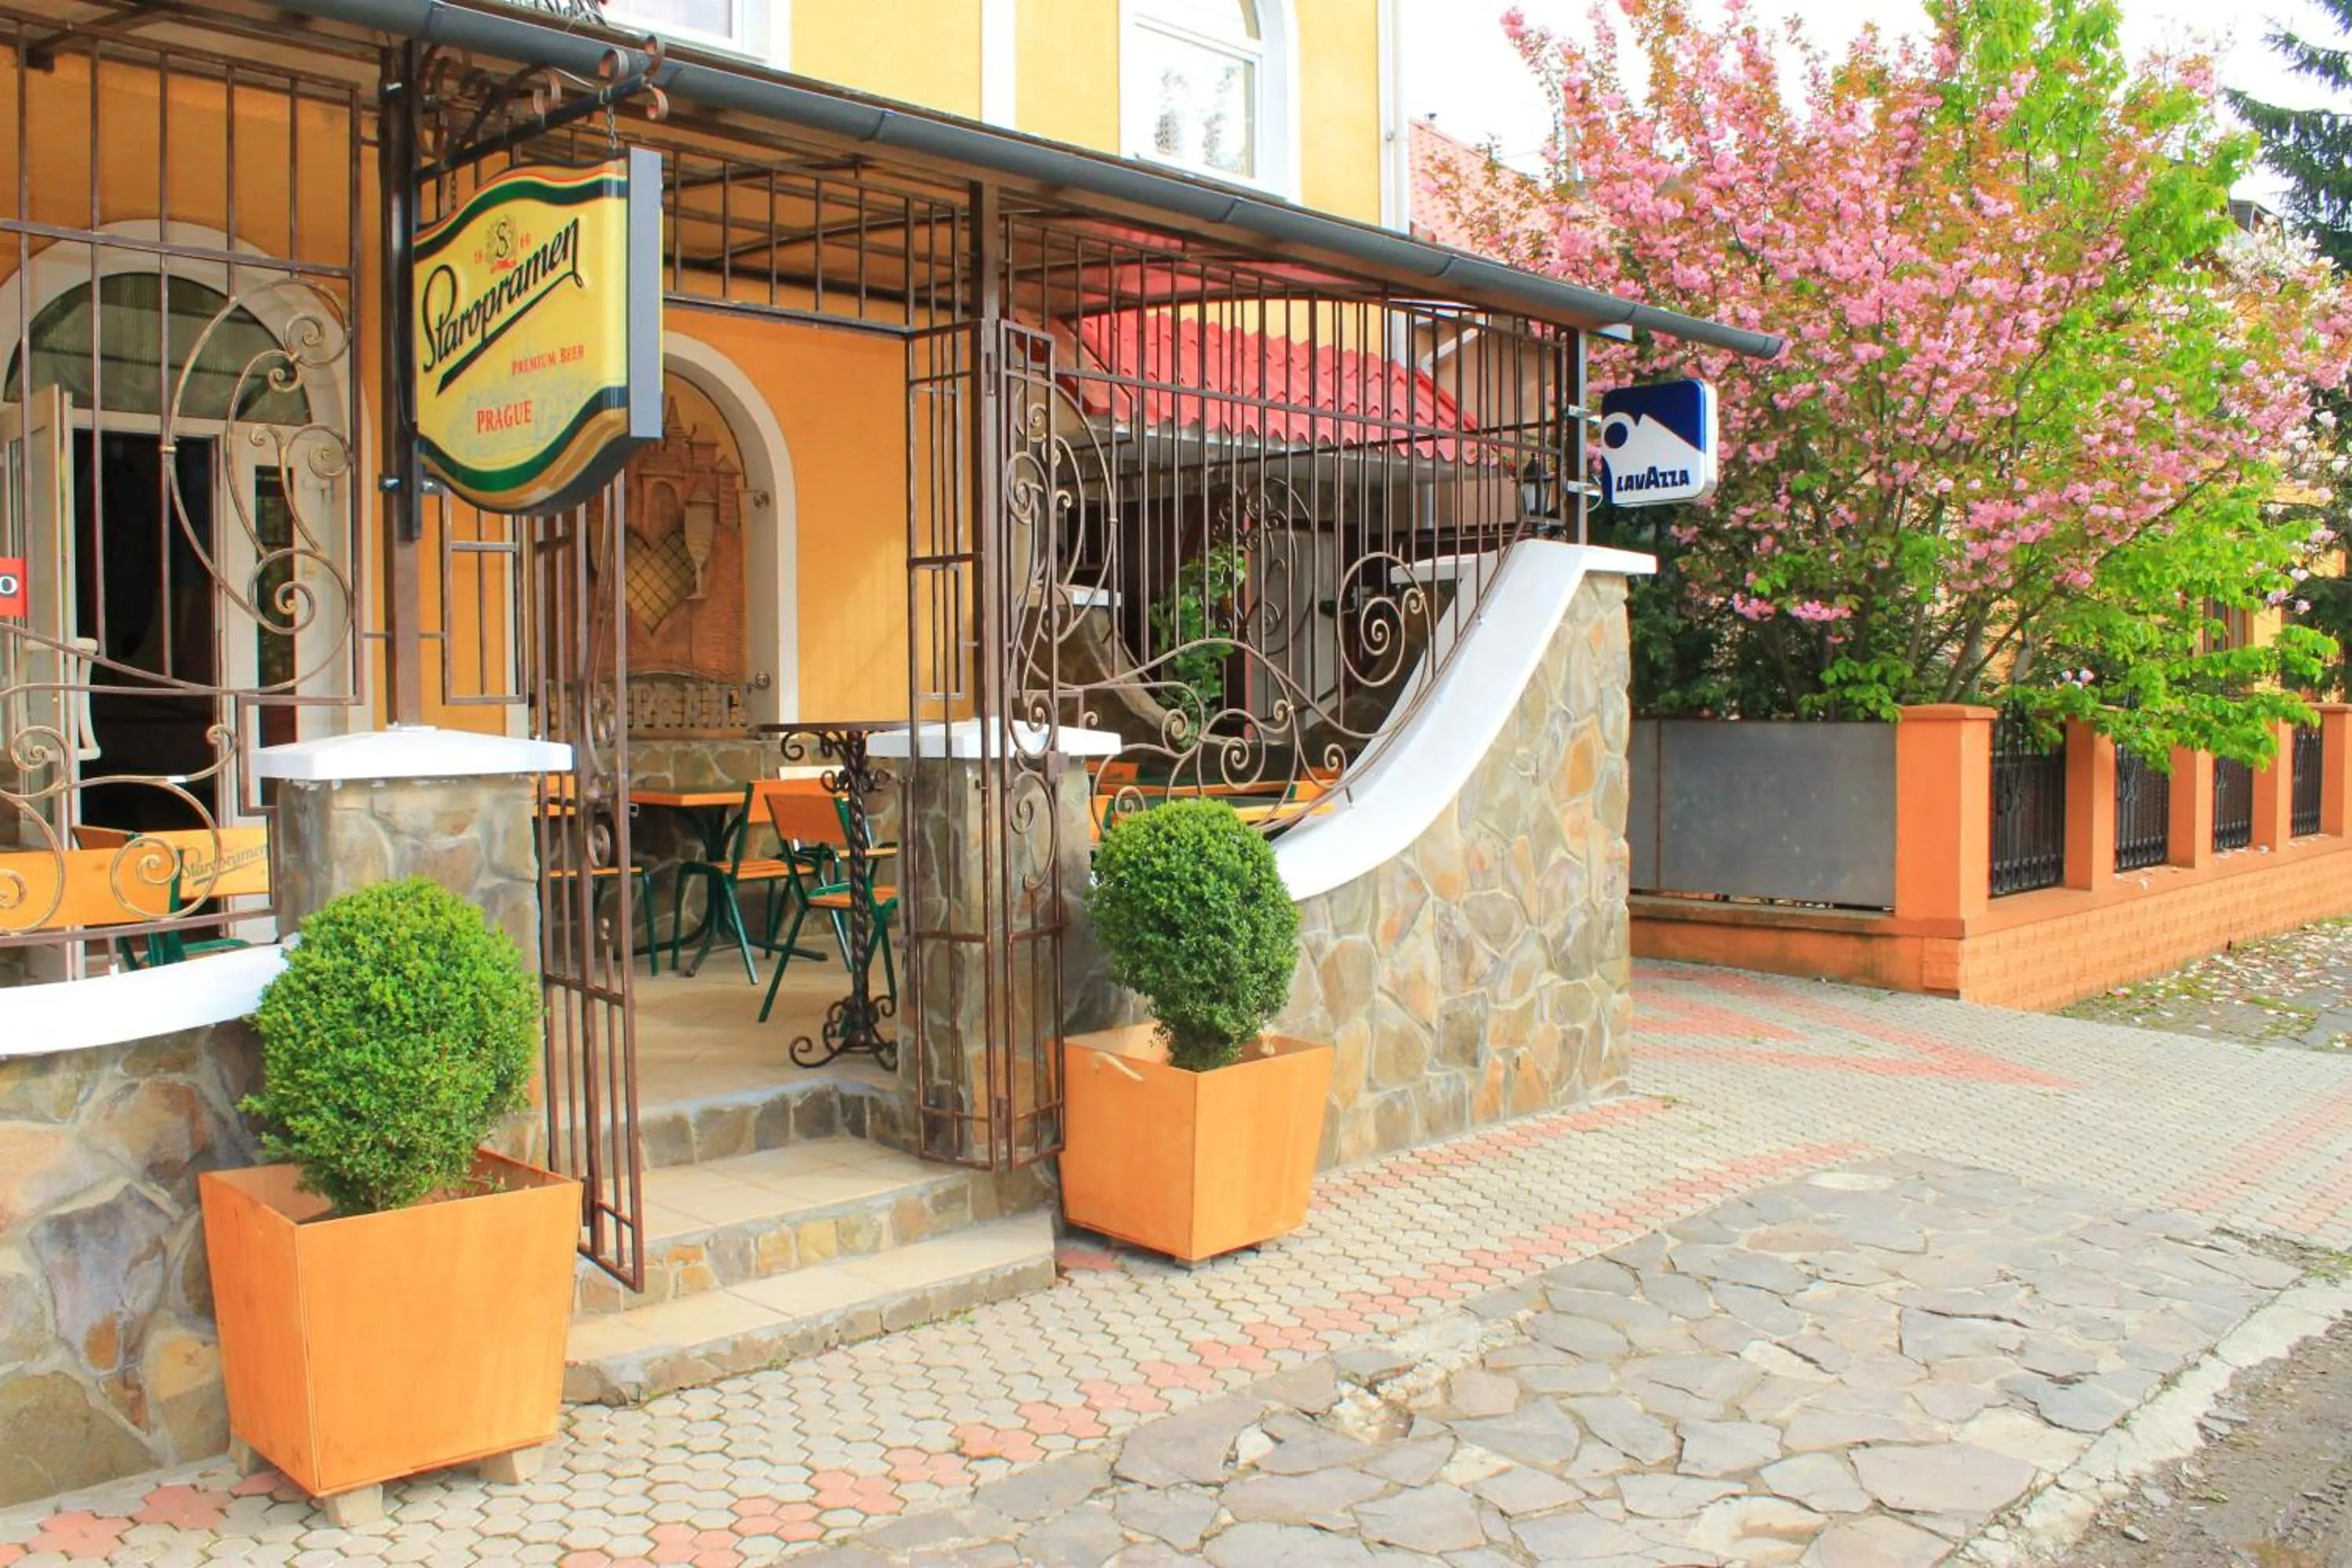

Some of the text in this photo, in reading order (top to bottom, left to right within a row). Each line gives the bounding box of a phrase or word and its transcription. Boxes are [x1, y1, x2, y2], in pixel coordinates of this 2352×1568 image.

[422, 216, 583, 374] Staropramen
[511, 343, 584, 376] PREMIUM BEER
[477, 401, 532, 434] PRAGUE
[1615, 466, 1690, 492] LAVAZZA
